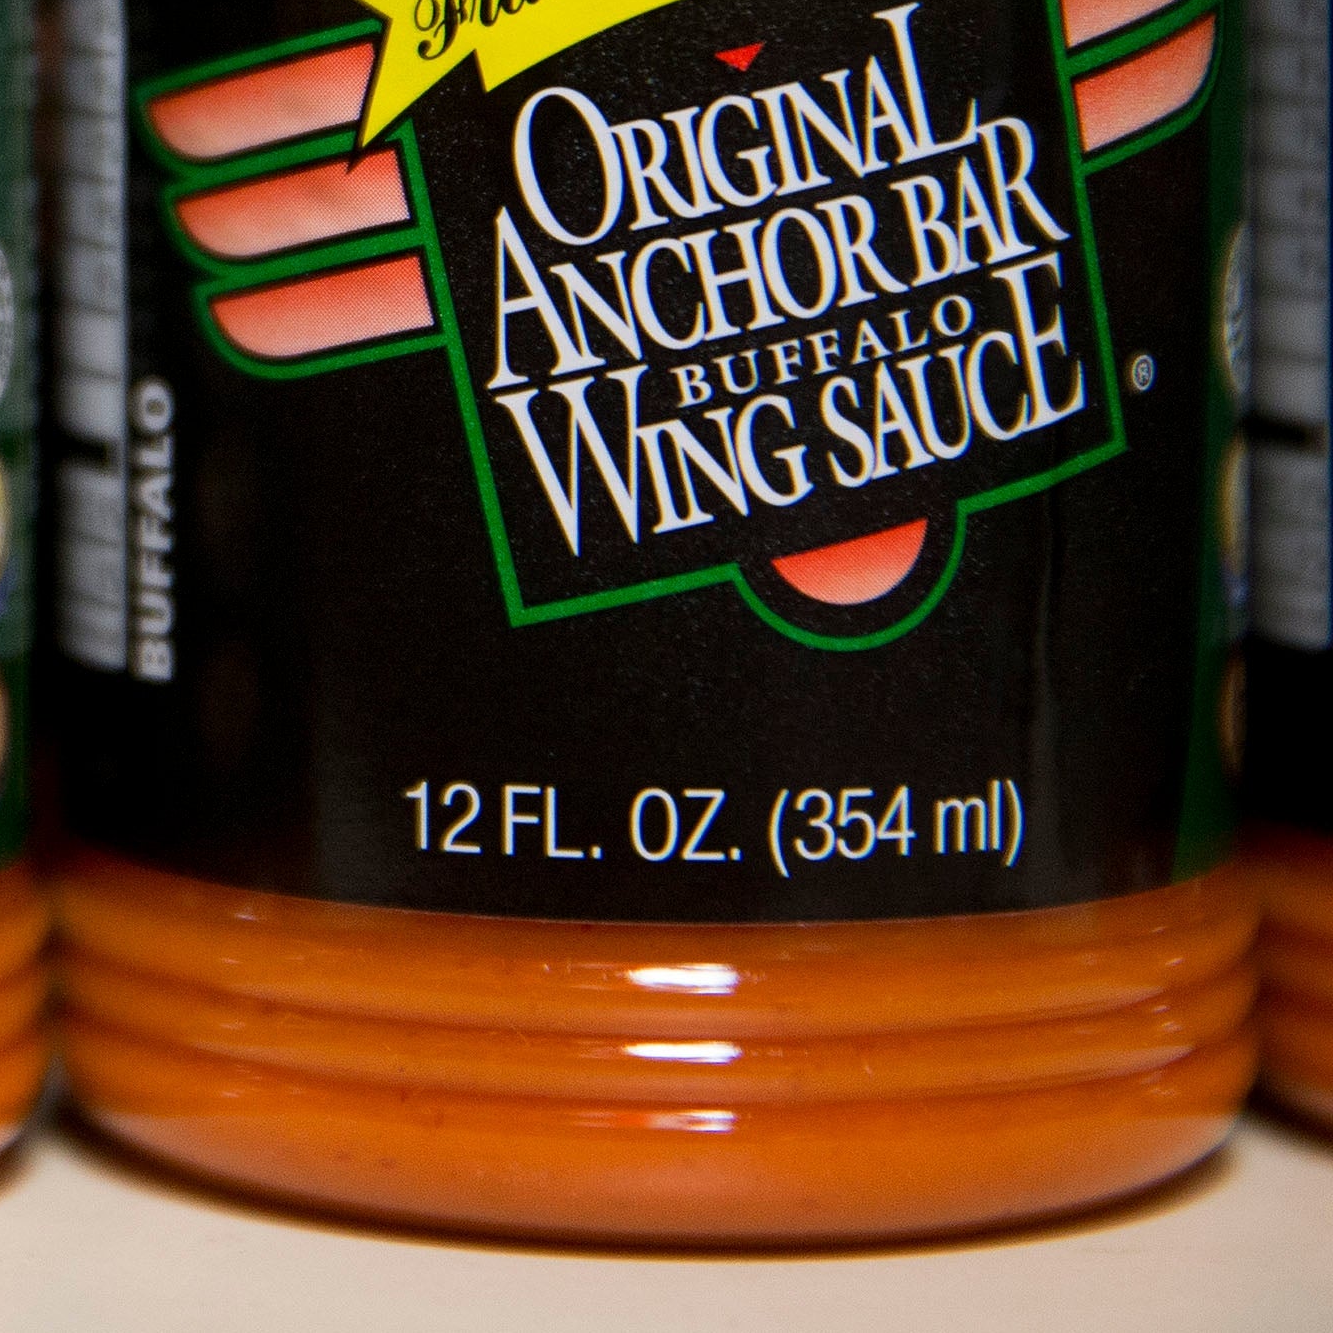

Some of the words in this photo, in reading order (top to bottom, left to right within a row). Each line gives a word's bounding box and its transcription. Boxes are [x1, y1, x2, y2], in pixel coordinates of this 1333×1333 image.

[486, 196, 910, 391] ANCHOR
[891, 116, 1071, 288] BAR
[513, 2, 979, 246] ORIGINAL
[495, 365, 813, 556] WING
[822, 252, 1085, 488] SAUCE
[670, 294, 974, 410] BUFFALO
[134, 377, 173, 683] BUFFALO
[406, 781, 481, 854] 12
[501, 785, 602, 860] FL.
[632, 787, 741, 862] OZ.
[769, 785, 915, 878] (354
[934, 779, 1025, 866] ml)
